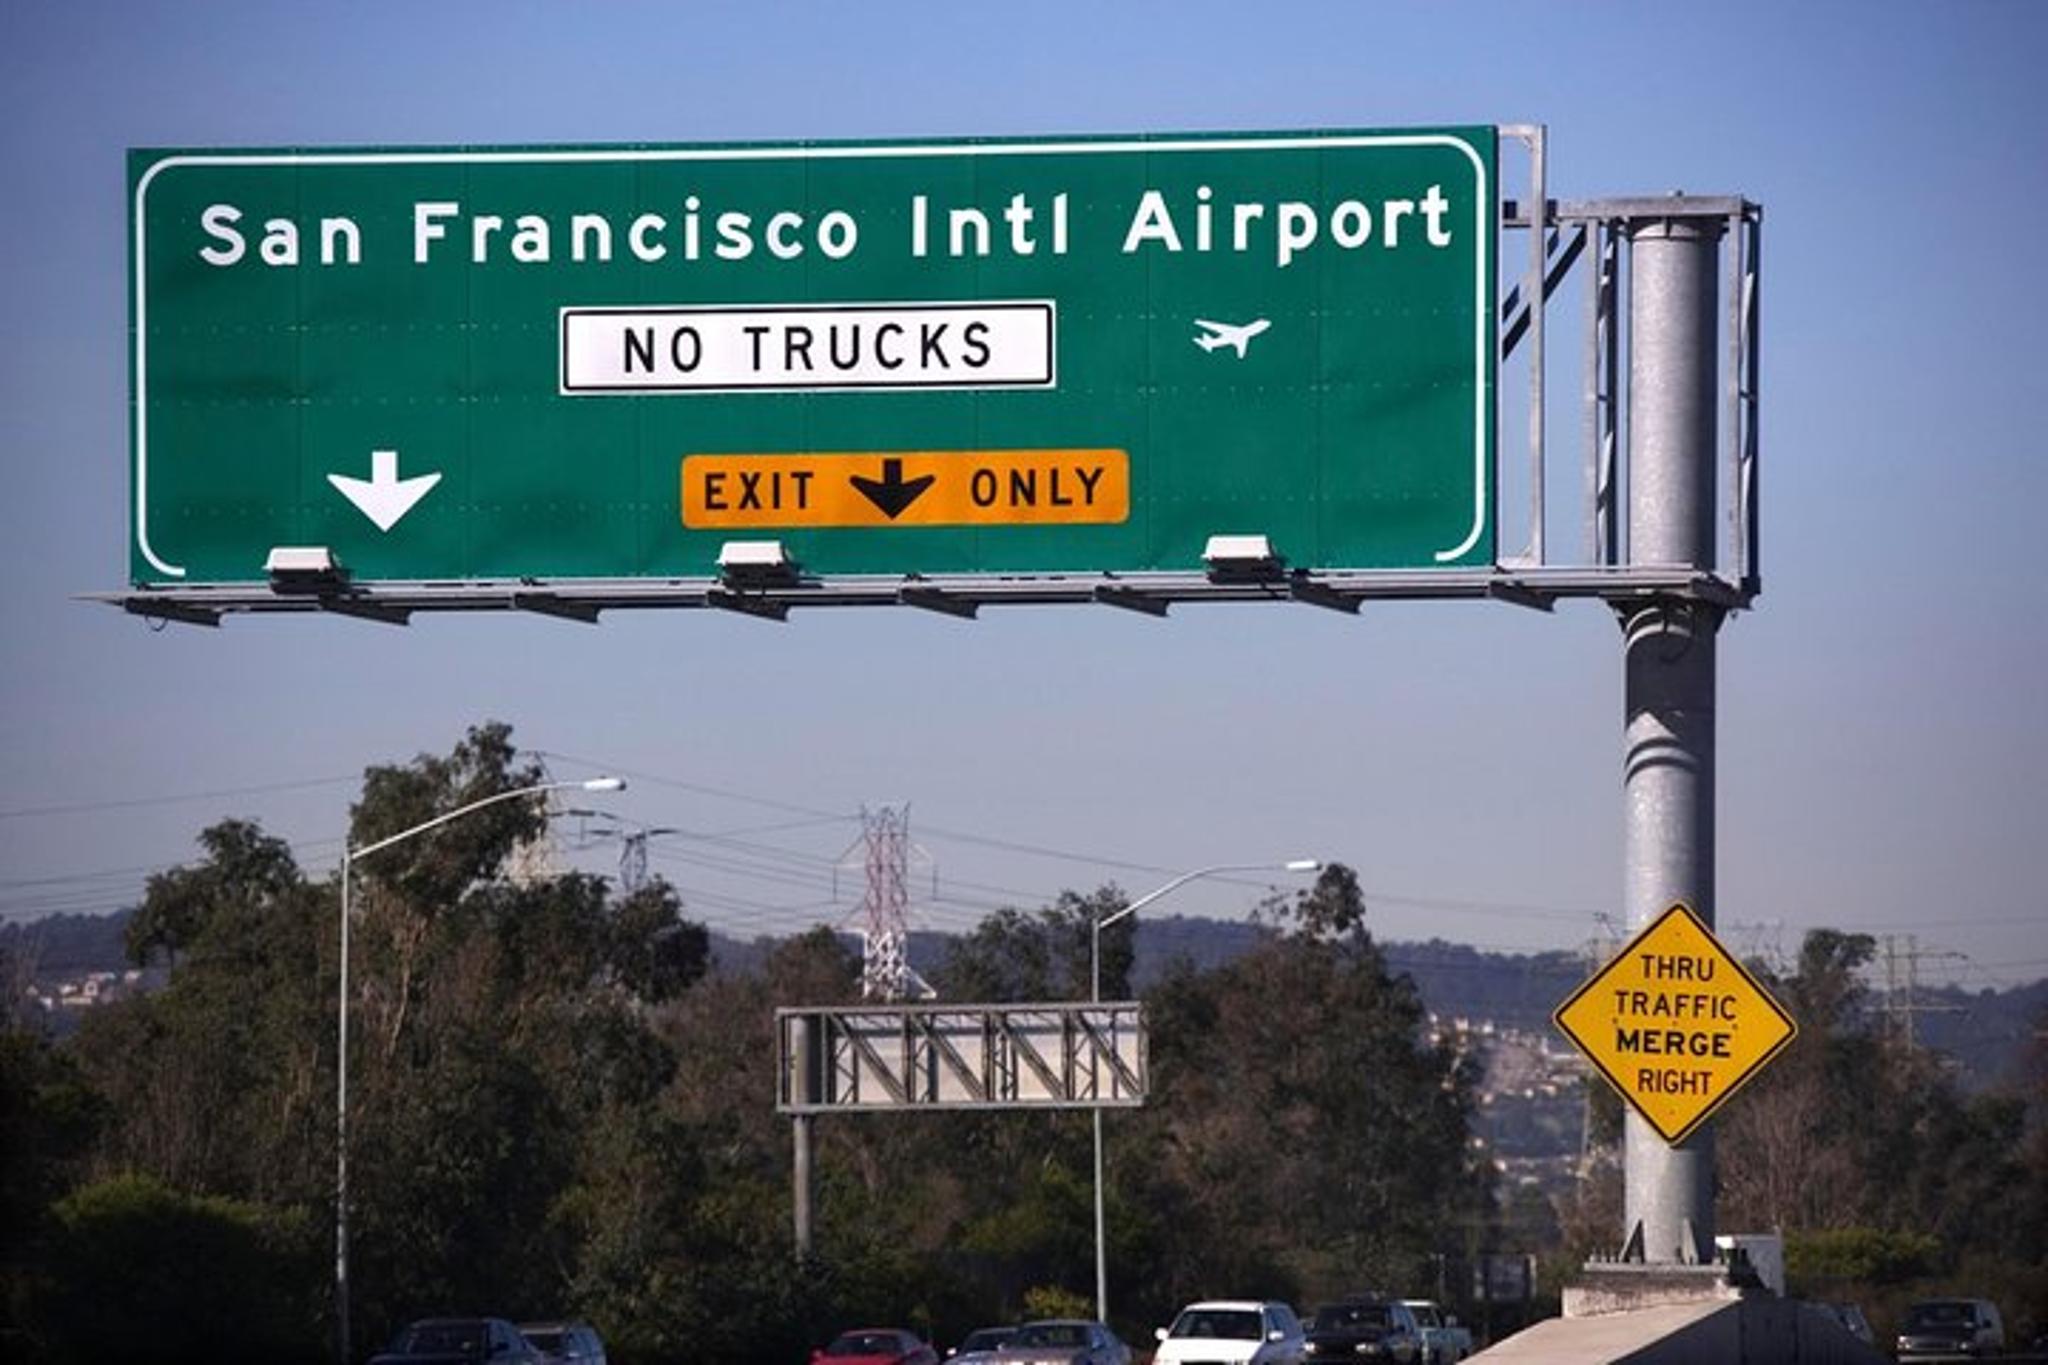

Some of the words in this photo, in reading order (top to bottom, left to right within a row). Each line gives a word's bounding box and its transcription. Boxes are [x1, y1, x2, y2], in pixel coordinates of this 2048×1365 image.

[199, 203, 361, 267] San
[413, 195, 859, 264] Francisco
[912, 192, 1069, 258] Intl
[1123, 184, 1453, 268] Airport
[623, 326, 704, 374] NO
[743, 322, 993, 371] TRUCKS
[704, 471, 815, 512] EXIT
[970, 467, 1105, 508] ONLY
[1641, 954, 1714, 982] THRU
[1615, 991, 1737, 1020] TRAFFIC
[1616, 1029, 1731, 1057] MERGE
[1637, 1069, 1713, 1095] RIGHT
